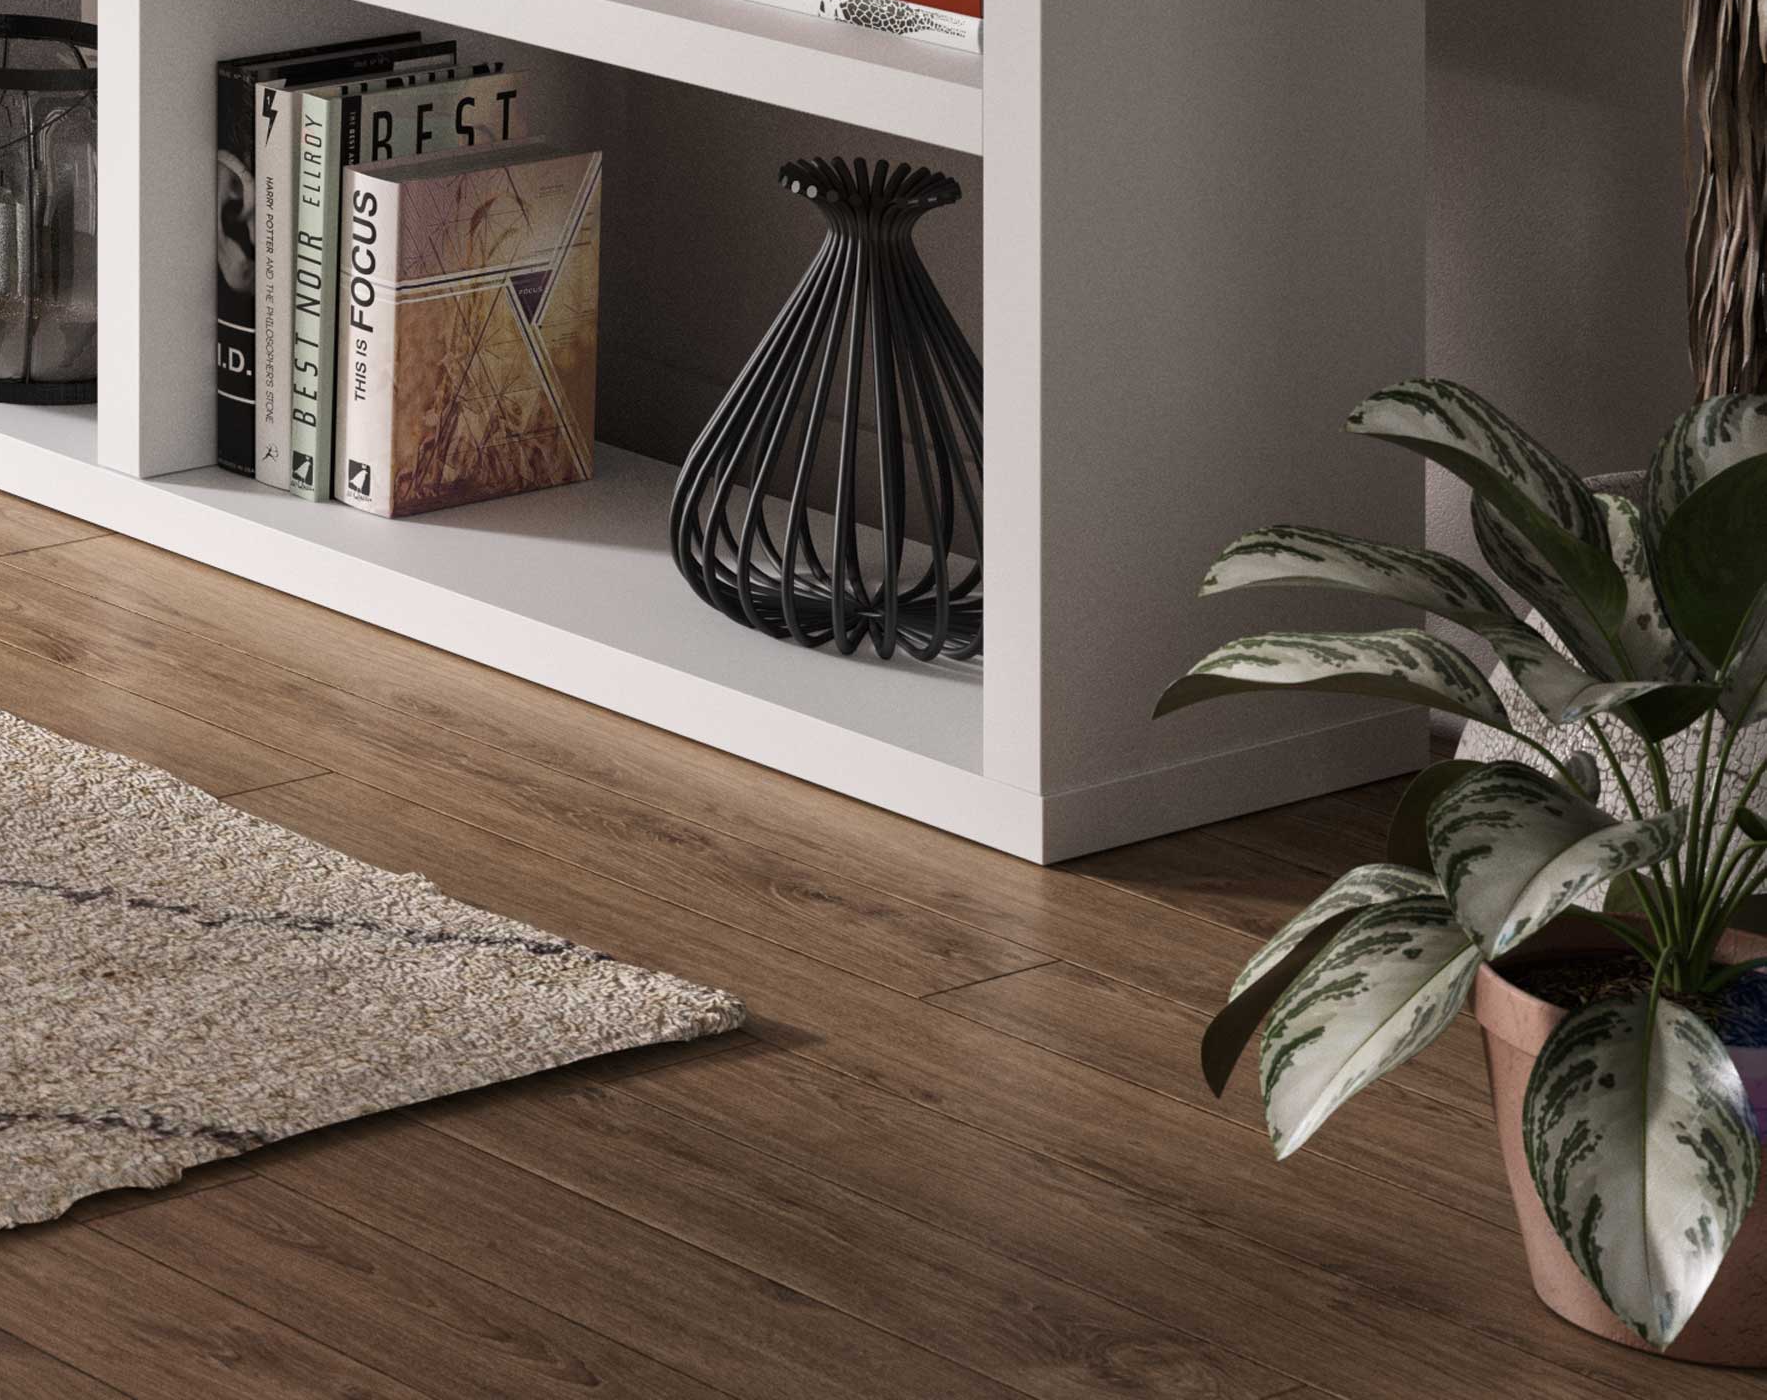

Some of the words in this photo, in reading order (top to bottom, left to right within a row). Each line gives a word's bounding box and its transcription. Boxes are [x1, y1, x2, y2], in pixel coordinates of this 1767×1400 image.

[302, 113, 324, 208] ELLROY
[265, 176, 274, 209] HARRY
[265, 213, 274, 254] POTTER
[265, 257, 274, 280] AND
[296, 230, 323, 316] NOIR
[351, 190, 378, 334] FOCUS
[265, 284, 274, 303] THE
[218, 342, 252, 376] I.D.
[265, 306, 275, 387] PHILOSOPHER'S
[355, 340, 367, 357] IS
[293, 336, 317, 428] BEST
[354, 363, 366, 401] THIS
[265, 391, 275, 424] STONE
